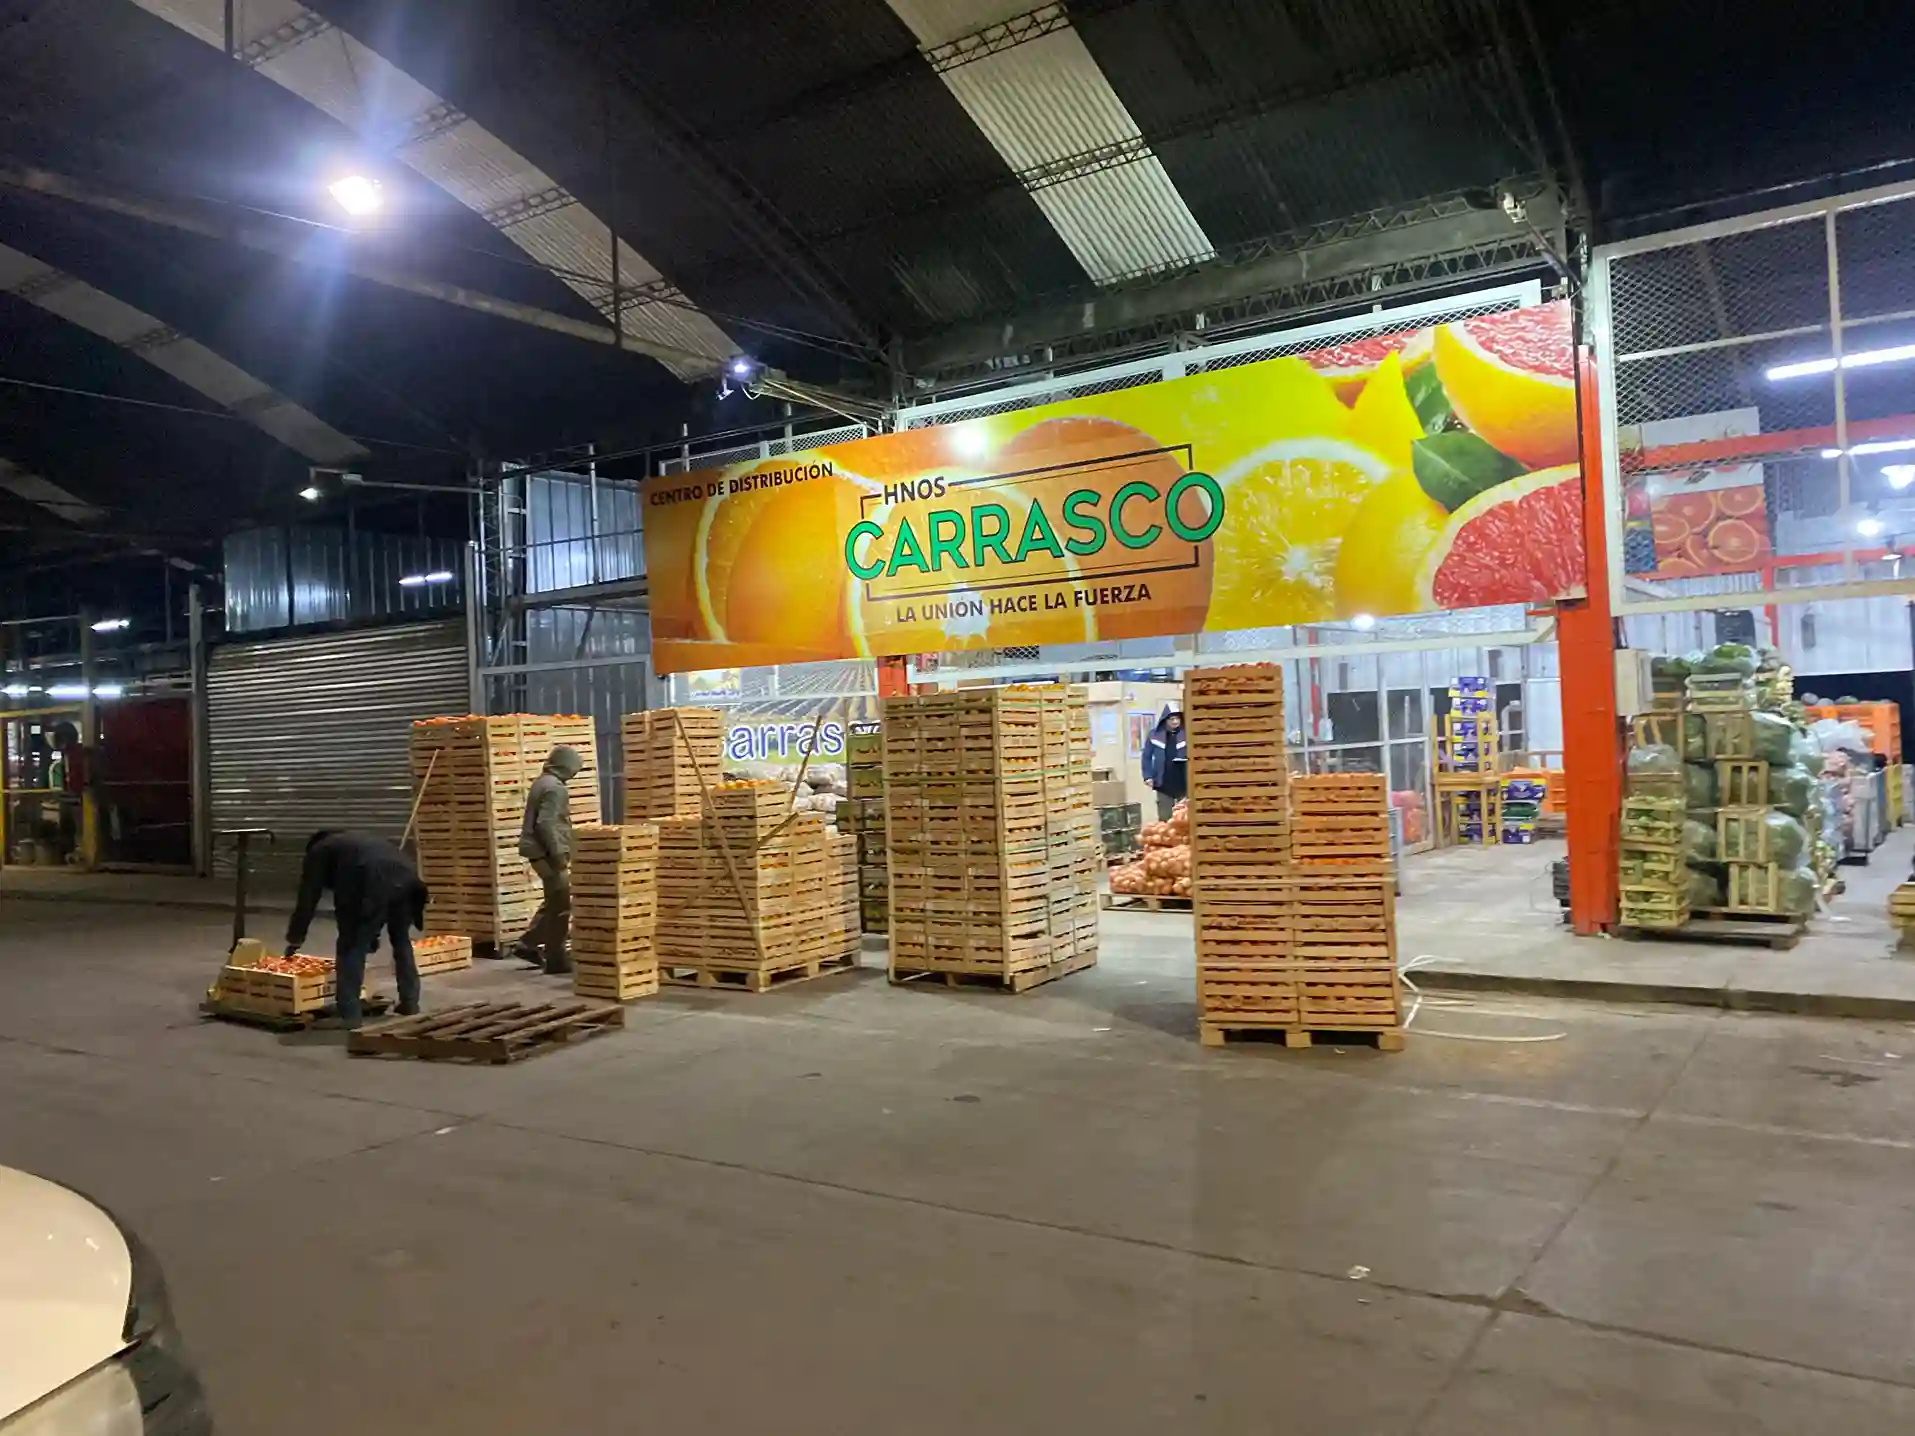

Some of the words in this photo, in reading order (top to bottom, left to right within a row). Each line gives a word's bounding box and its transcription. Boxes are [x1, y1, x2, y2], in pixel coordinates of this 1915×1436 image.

[650, 485, 703, 506] CENTRO
[706, 480, 725, 497] DE
[729, 459, 834, 493] DISTRIBUCIÓN
[883, 476, 947, 505] HNOS
[844, 471, 1225, 581] CARRASCO
[896, 606, 917, 623] LA
[922, 597, 984, 621] UNIÓN
[989, 594, 1038, 615] HACE
[1044, 592, 1068, 610] LA
[1074, 583, 1152, 607] FUERZA
[723, 721, 844, 762] arras
